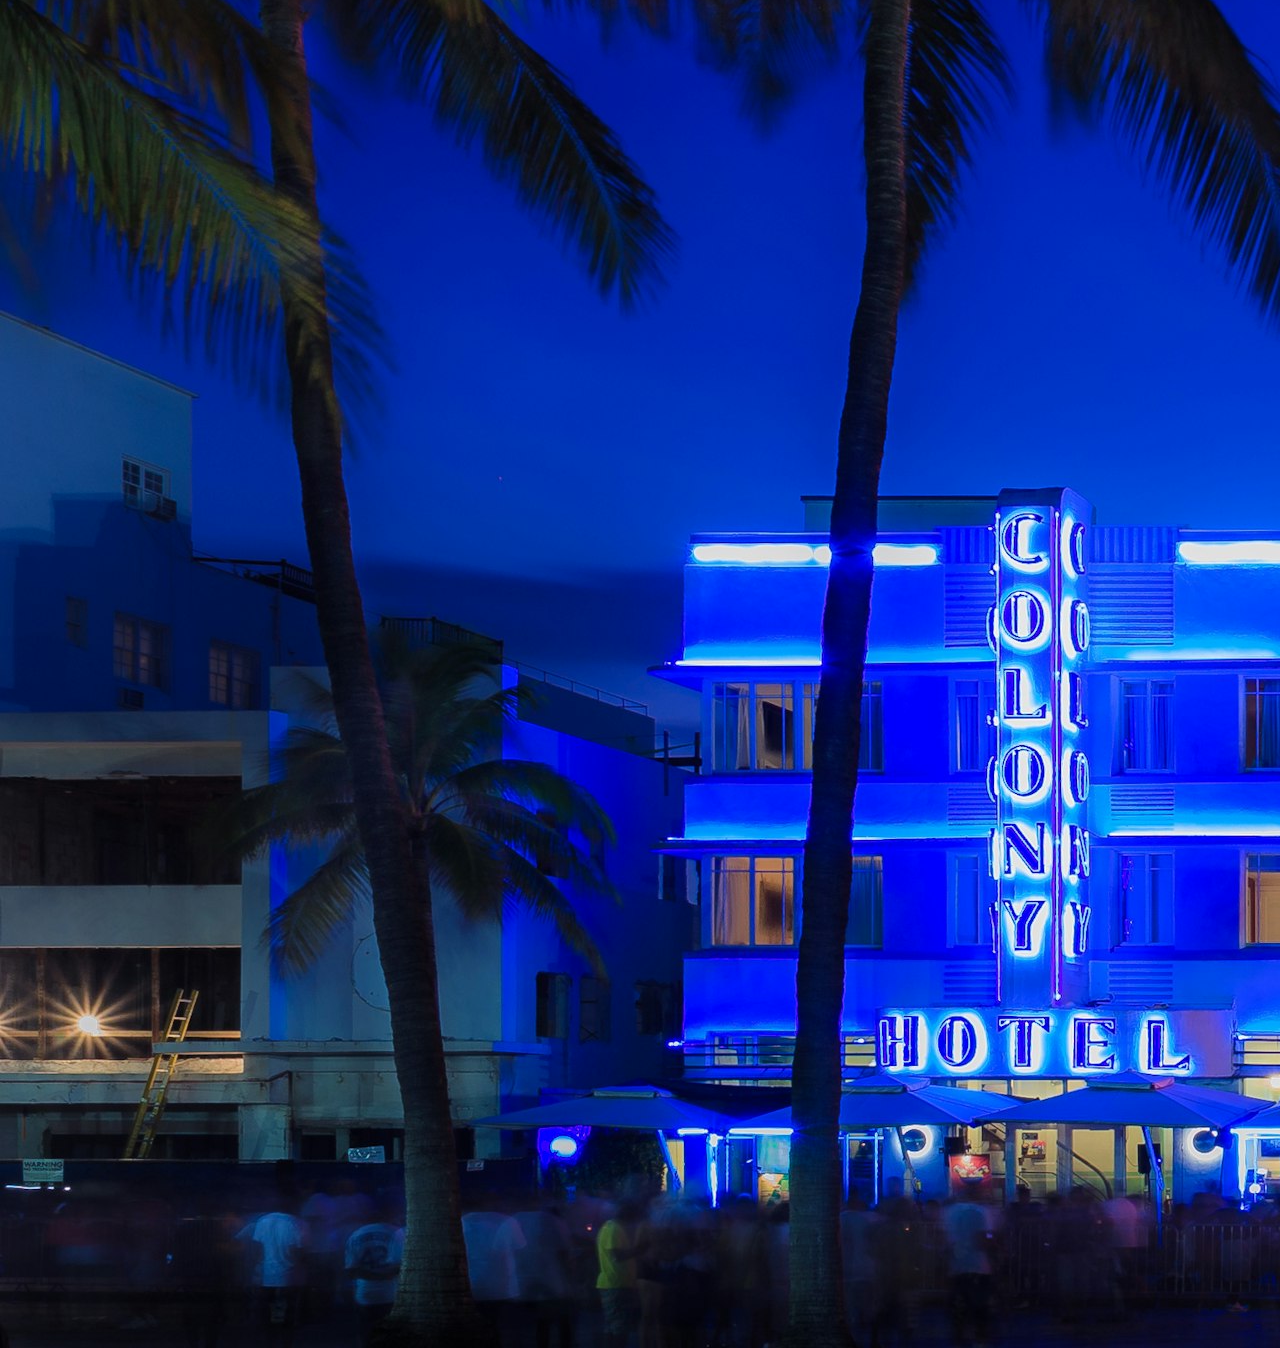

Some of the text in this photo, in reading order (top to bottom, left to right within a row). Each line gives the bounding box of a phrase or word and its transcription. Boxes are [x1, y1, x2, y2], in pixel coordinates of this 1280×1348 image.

[1001, 512, 1049, 955] COLONY
[1065, 522, 1091, 954] COLONY
[879, 1015, 1191, 1072] HOTEL
